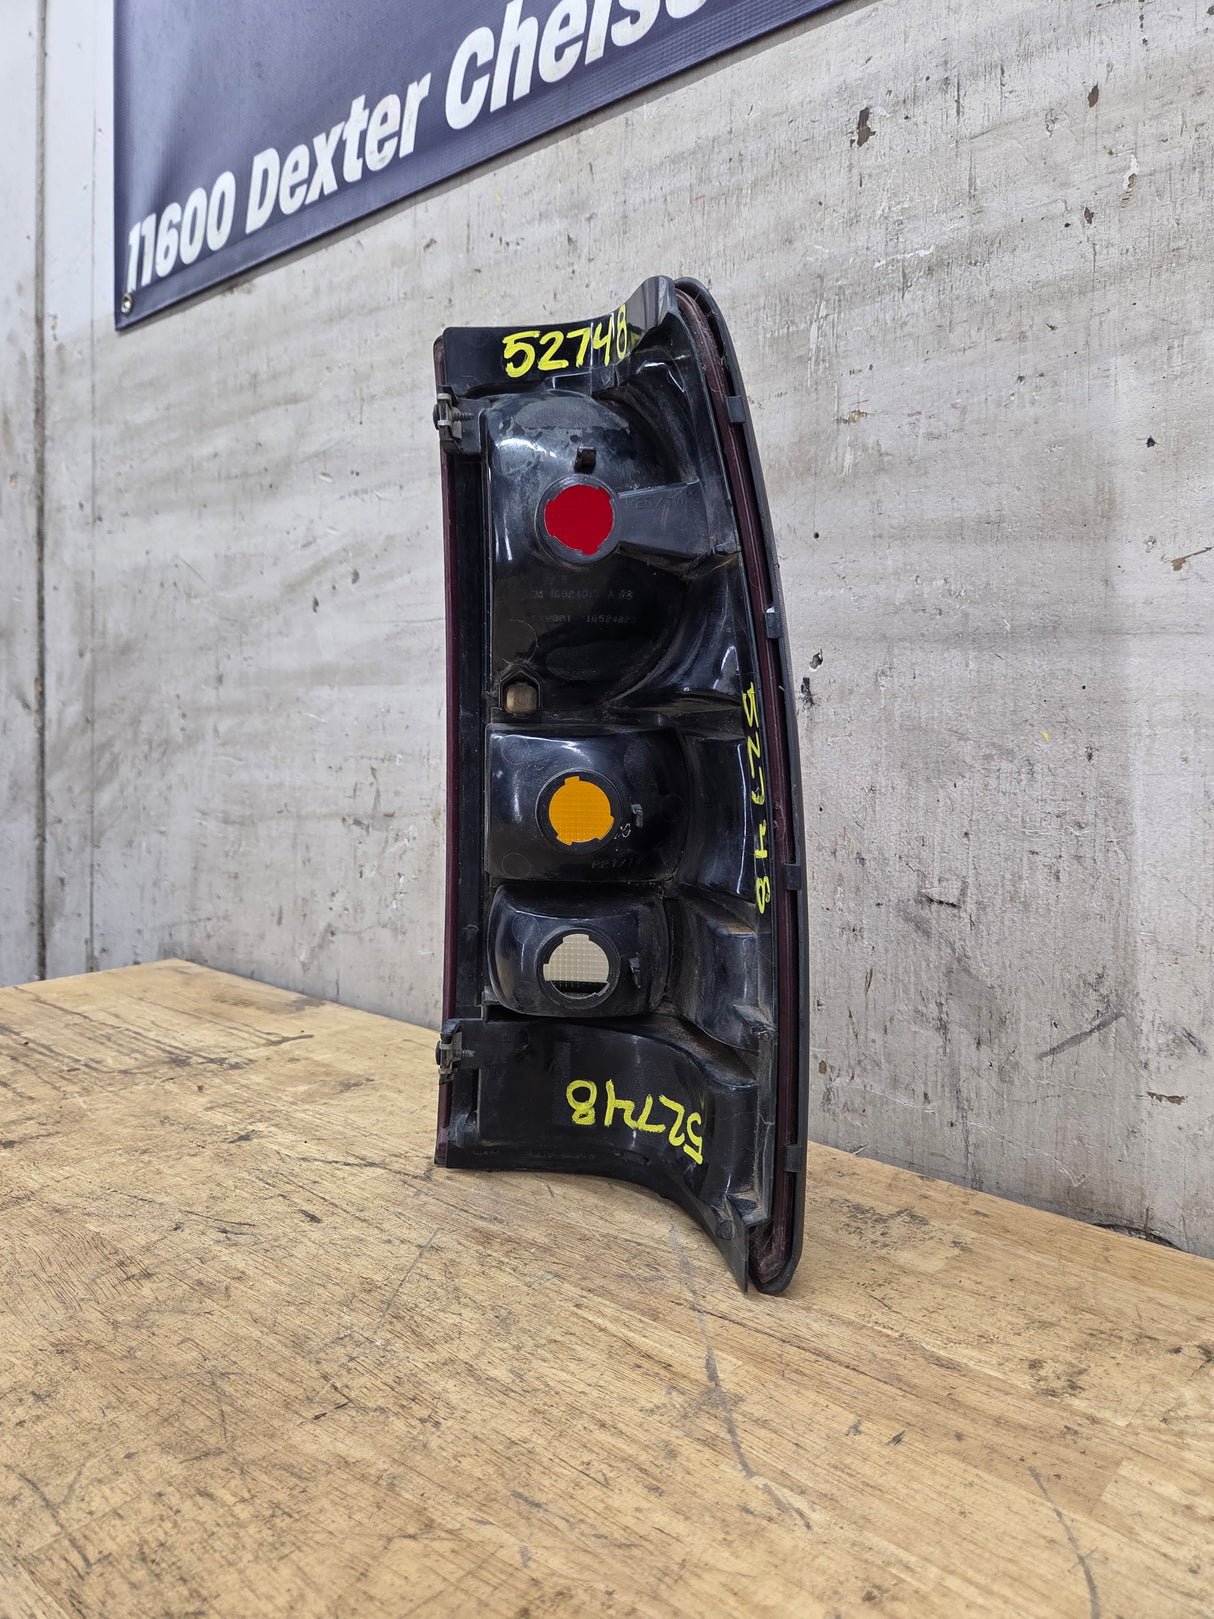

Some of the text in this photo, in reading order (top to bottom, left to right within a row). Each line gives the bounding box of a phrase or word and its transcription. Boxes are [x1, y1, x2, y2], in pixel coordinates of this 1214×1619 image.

[127, 171, 236, 293] 11600
[246, 72, 432, 235] Dexter
[502, 303, 628, 378] 52748
[742, 682, 771, 914] 52748
[566, 1079, 703, 1165] 52748
